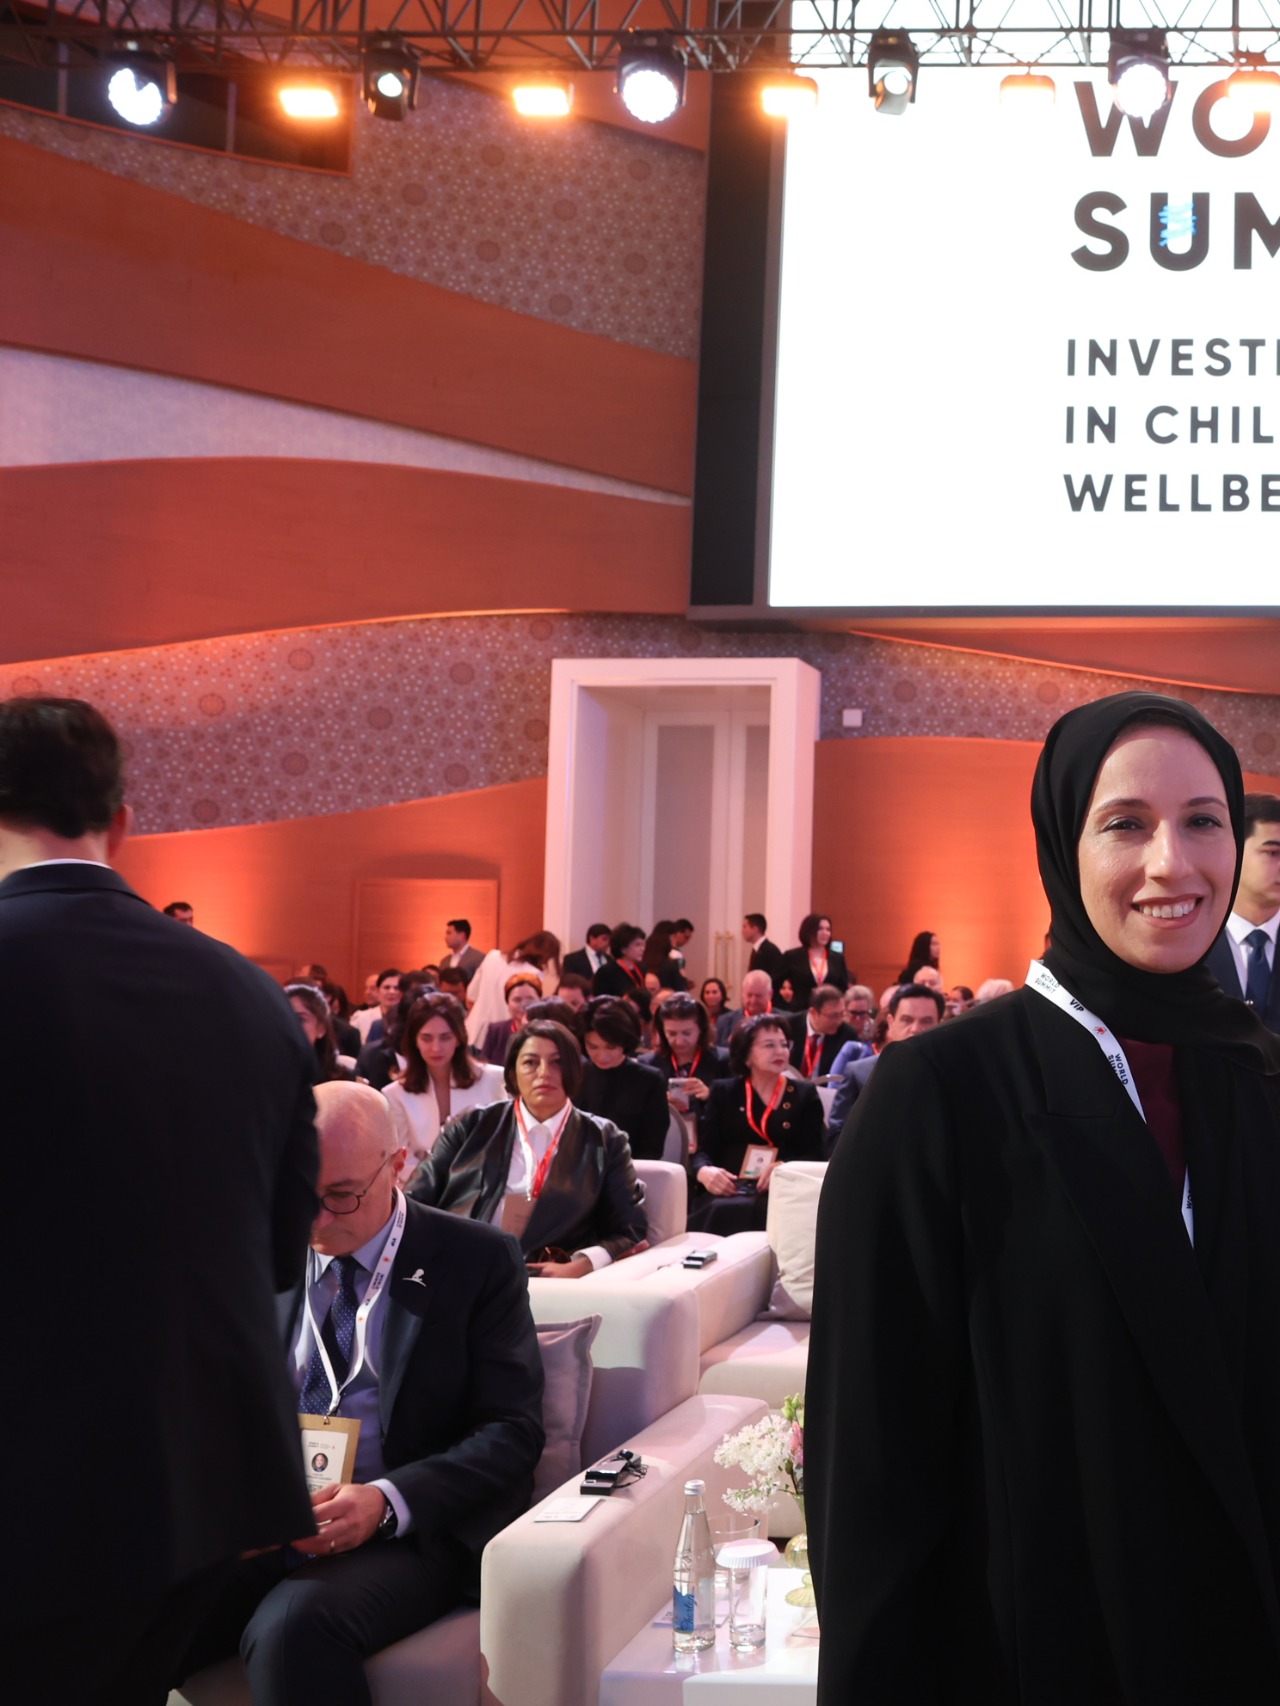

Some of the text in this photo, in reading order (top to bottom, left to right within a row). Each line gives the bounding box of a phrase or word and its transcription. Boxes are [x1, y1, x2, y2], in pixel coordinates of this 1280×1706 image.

[1065, 405, 1117, 445] IN
[1034, 977, 1057, 994] SUMMIT
[1040, 972, 1061, 989] WORLD
[1069, 998, 1085, 1012] VIP
[1114, 1053, 1129, 1085] WORLD
